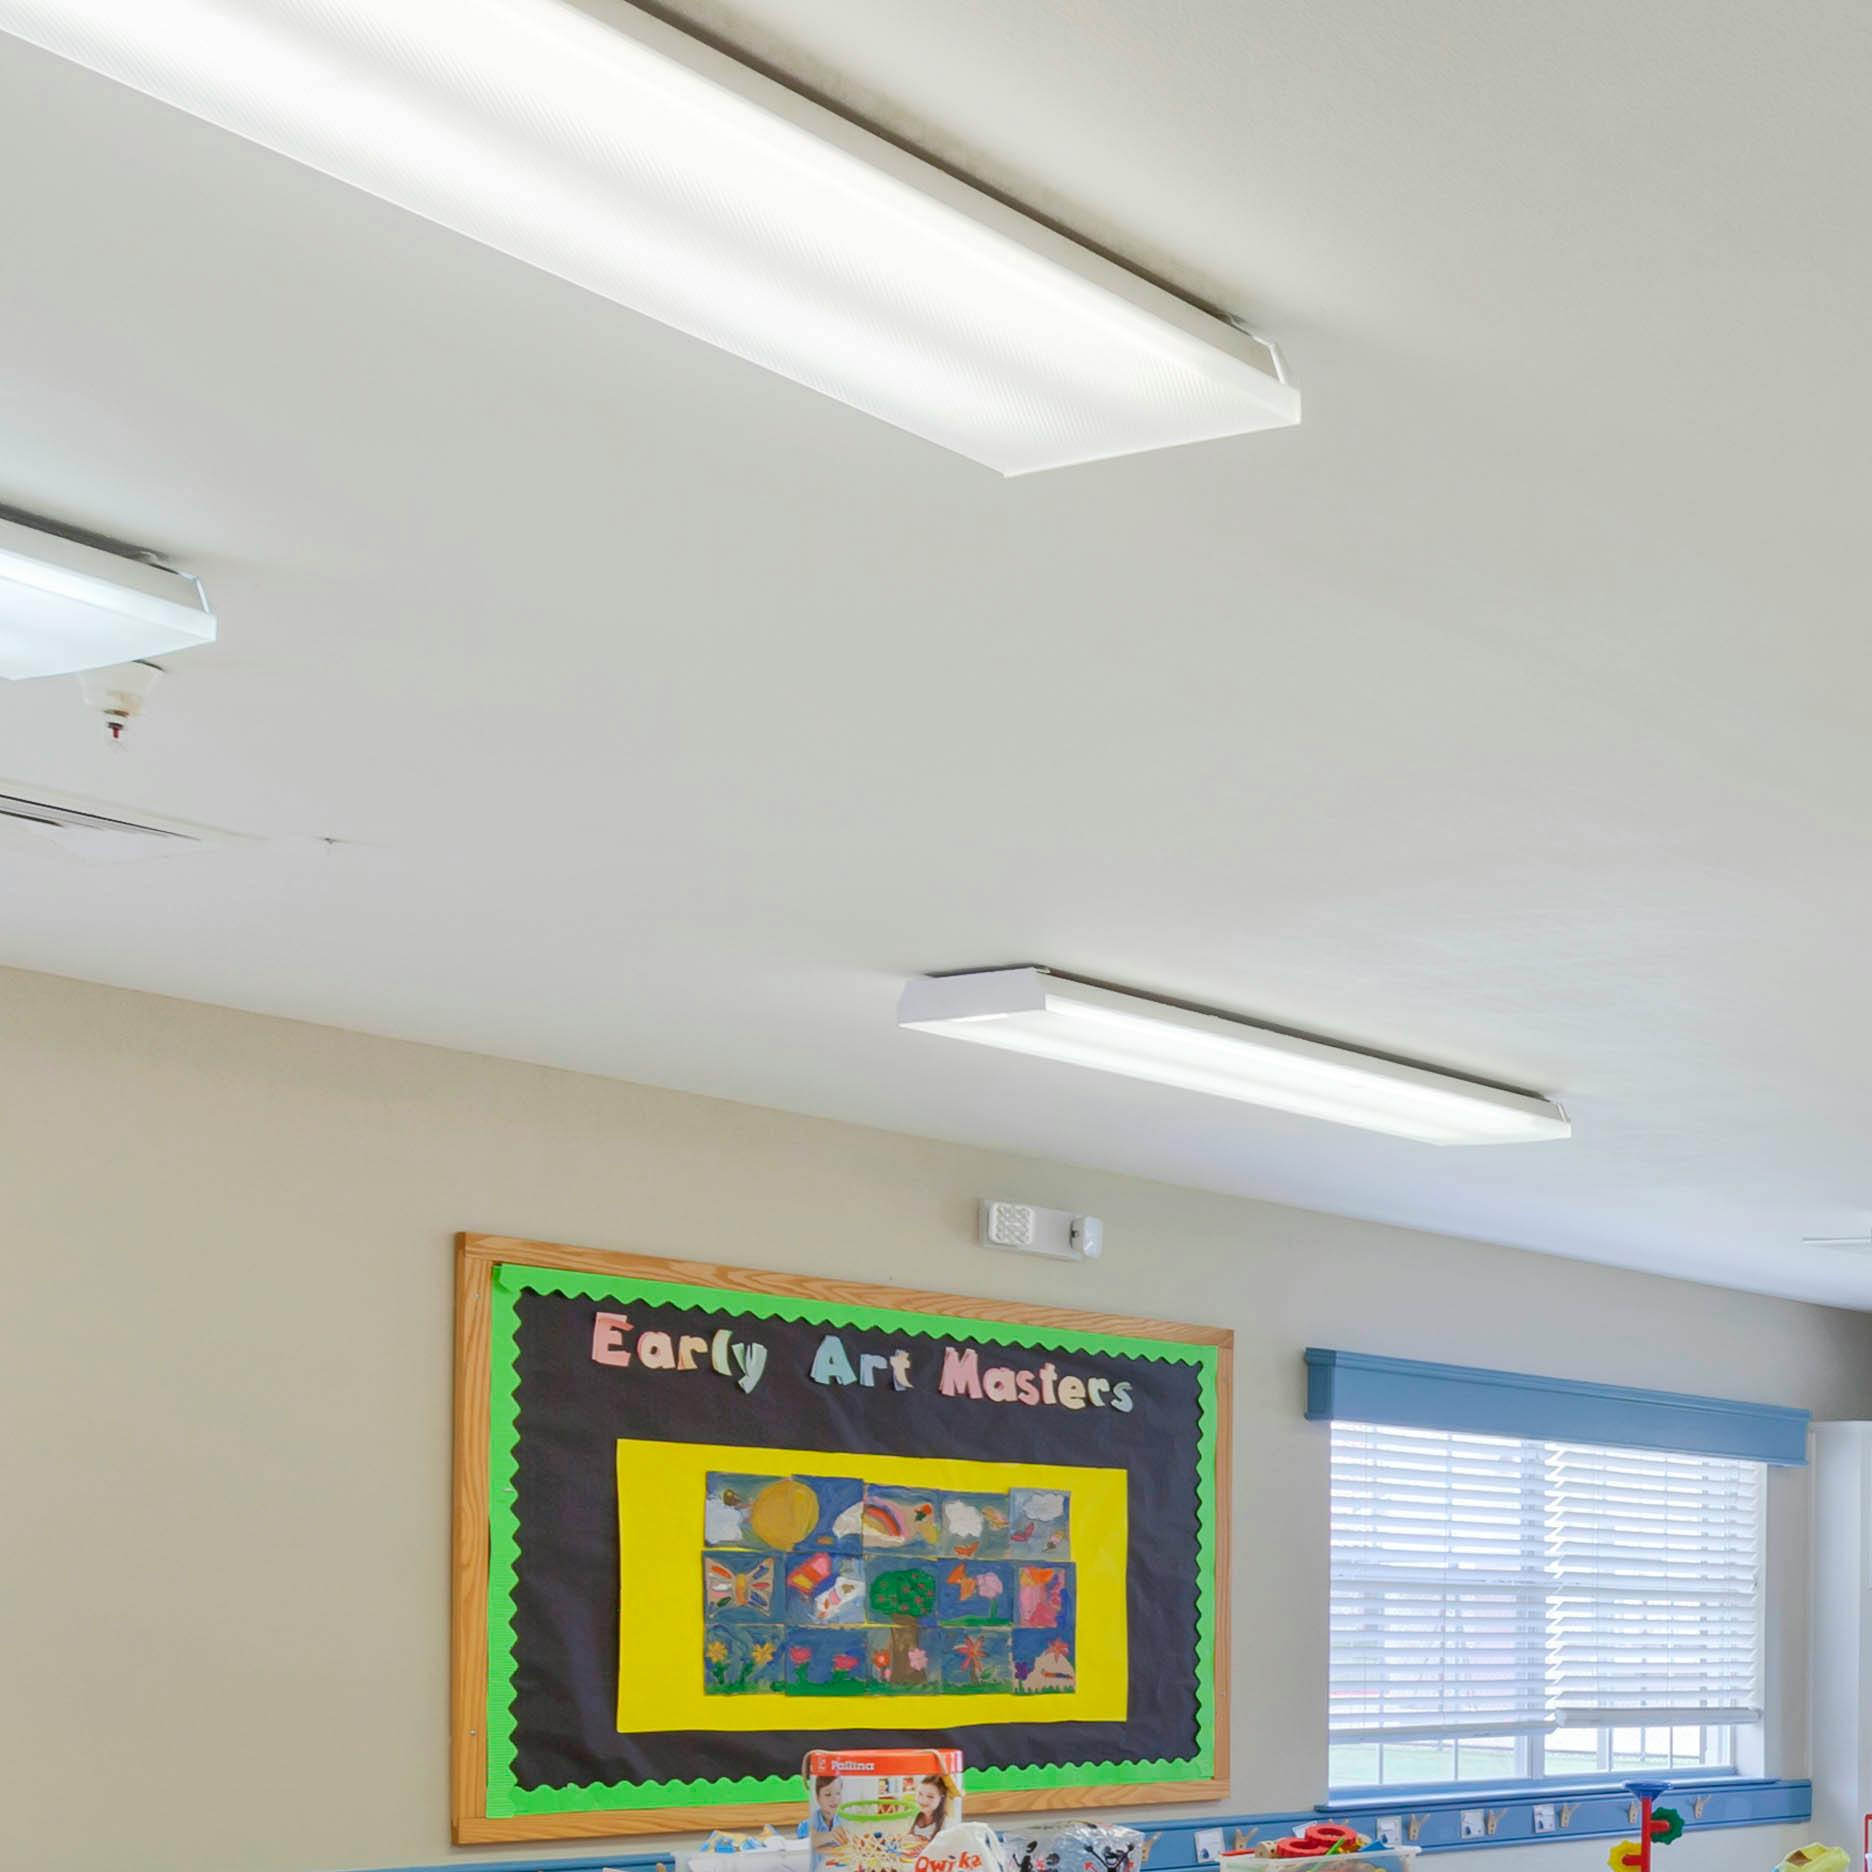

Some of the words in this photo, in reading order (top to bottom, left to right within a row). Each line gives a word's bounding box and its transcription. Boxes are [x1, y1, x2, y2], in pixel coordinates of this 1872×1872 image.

[591, 1312, 768, 1394] Early
[810, 1335, 915, 1391] Art
[938, 1346, 1133, 1413] Masters
[830, 1759, 876, 1772] Pallina
